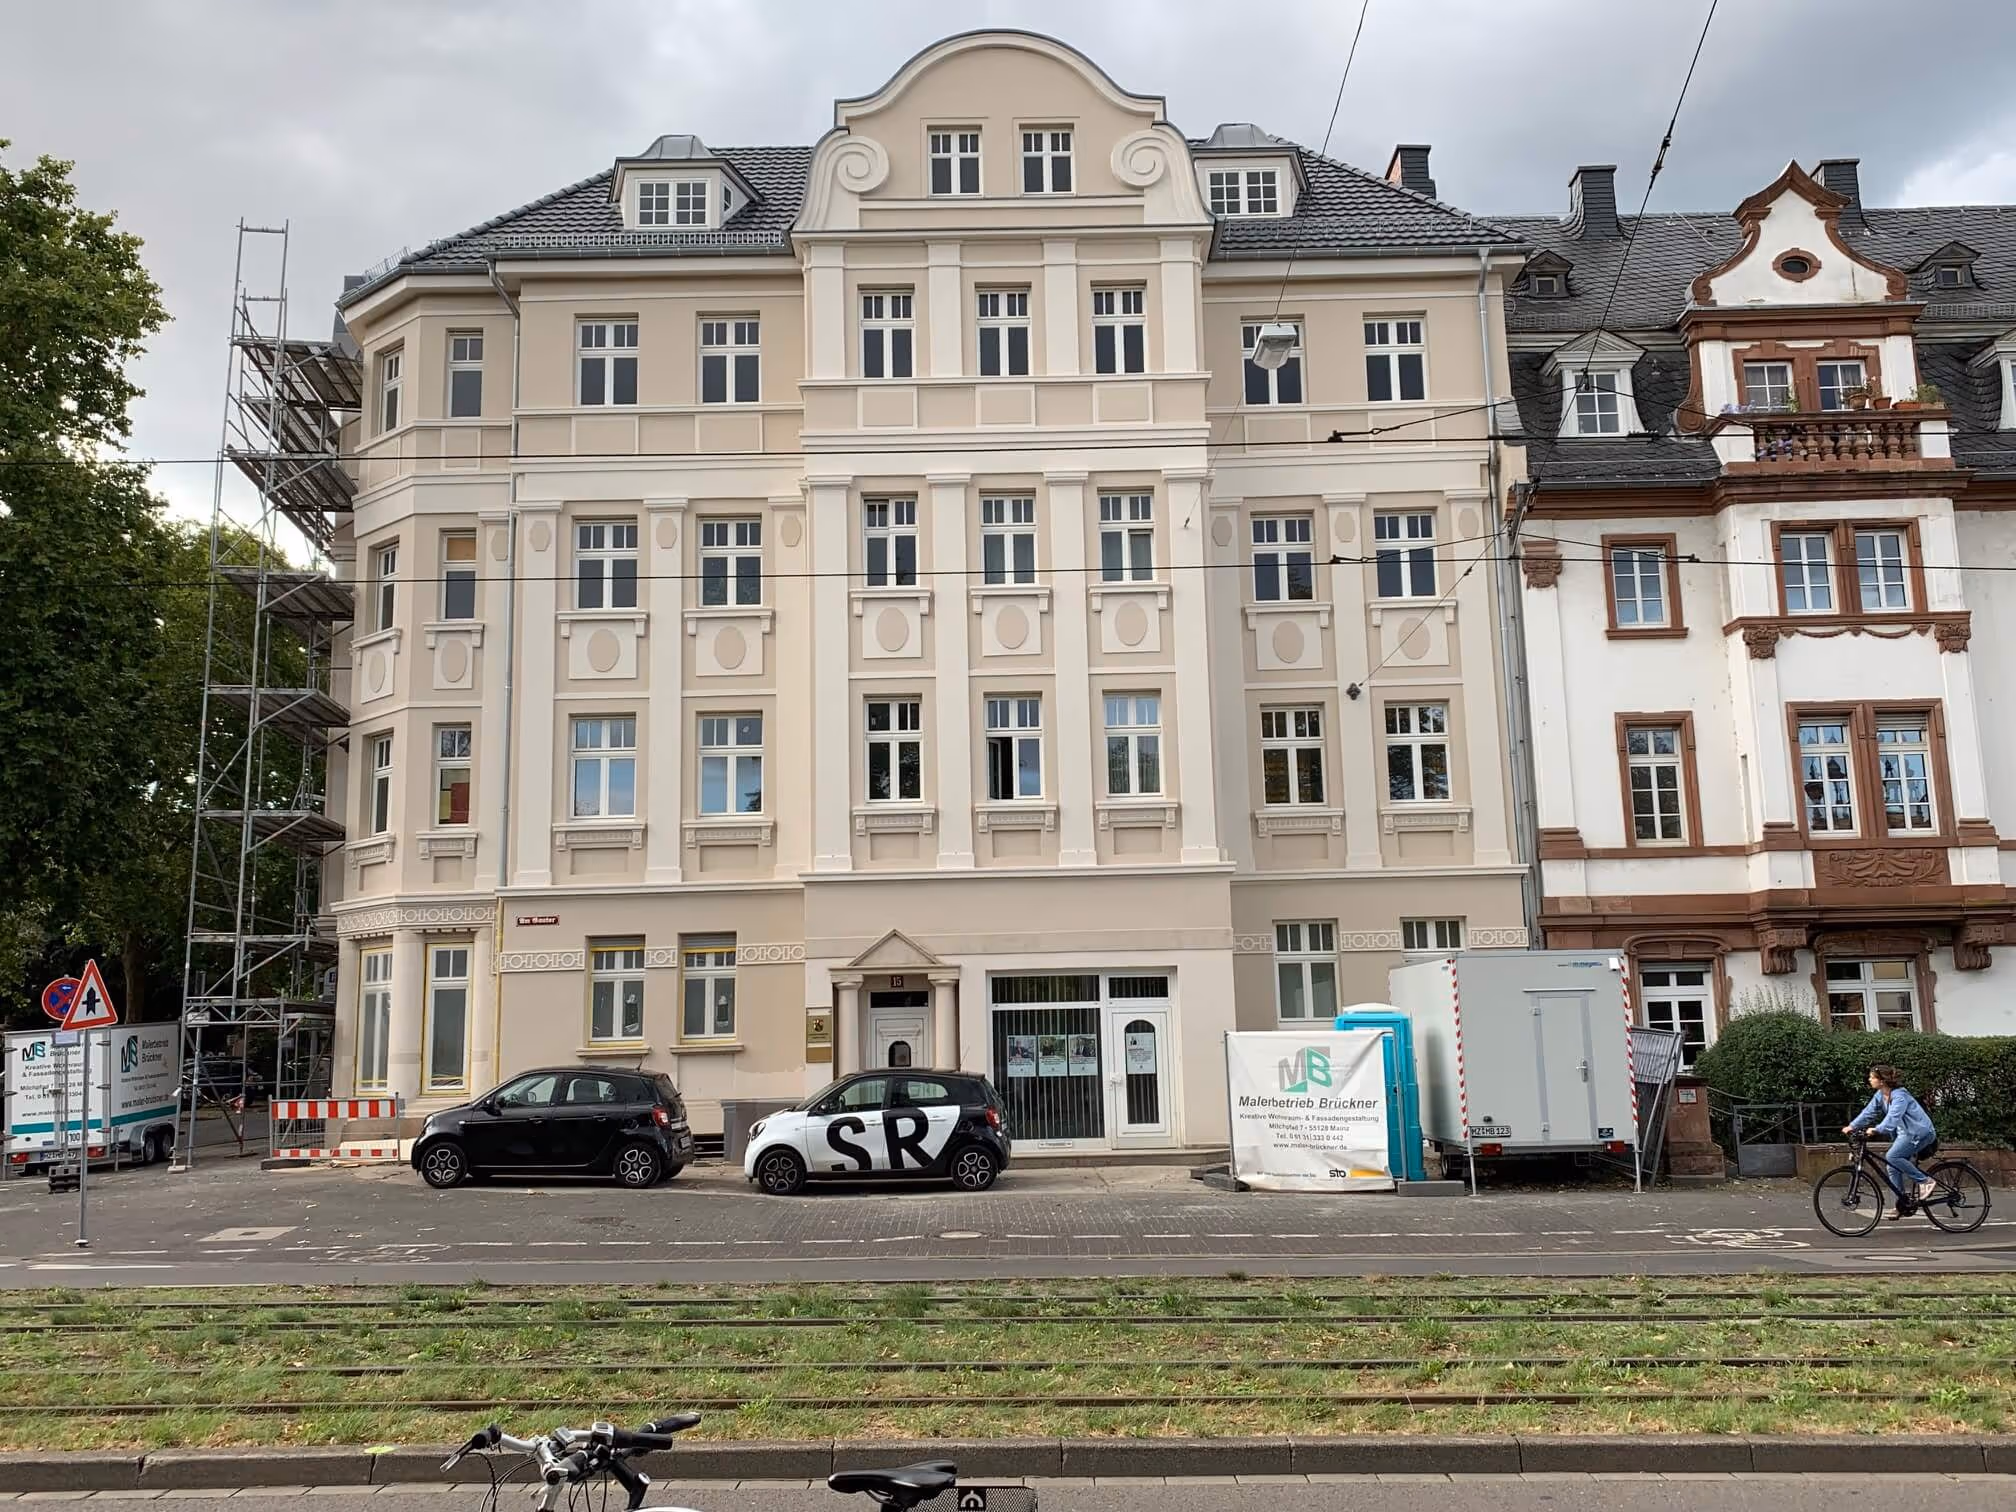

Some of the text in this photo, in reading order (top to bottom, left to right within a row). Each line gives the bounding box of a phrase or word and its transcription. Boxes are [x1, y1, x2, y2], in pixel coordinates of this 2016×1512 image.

[893, 976, 902, 986] 15
[22, 1041, 45, 1061] MB
[1278, 1046, 1332, 1093] MB
[1239, 1096, 1379, 1109] Malerbetrieb Brückner
[1496, 1127, 1510, 1135] 123
[1329, 1168, 1347, 1178] sto
